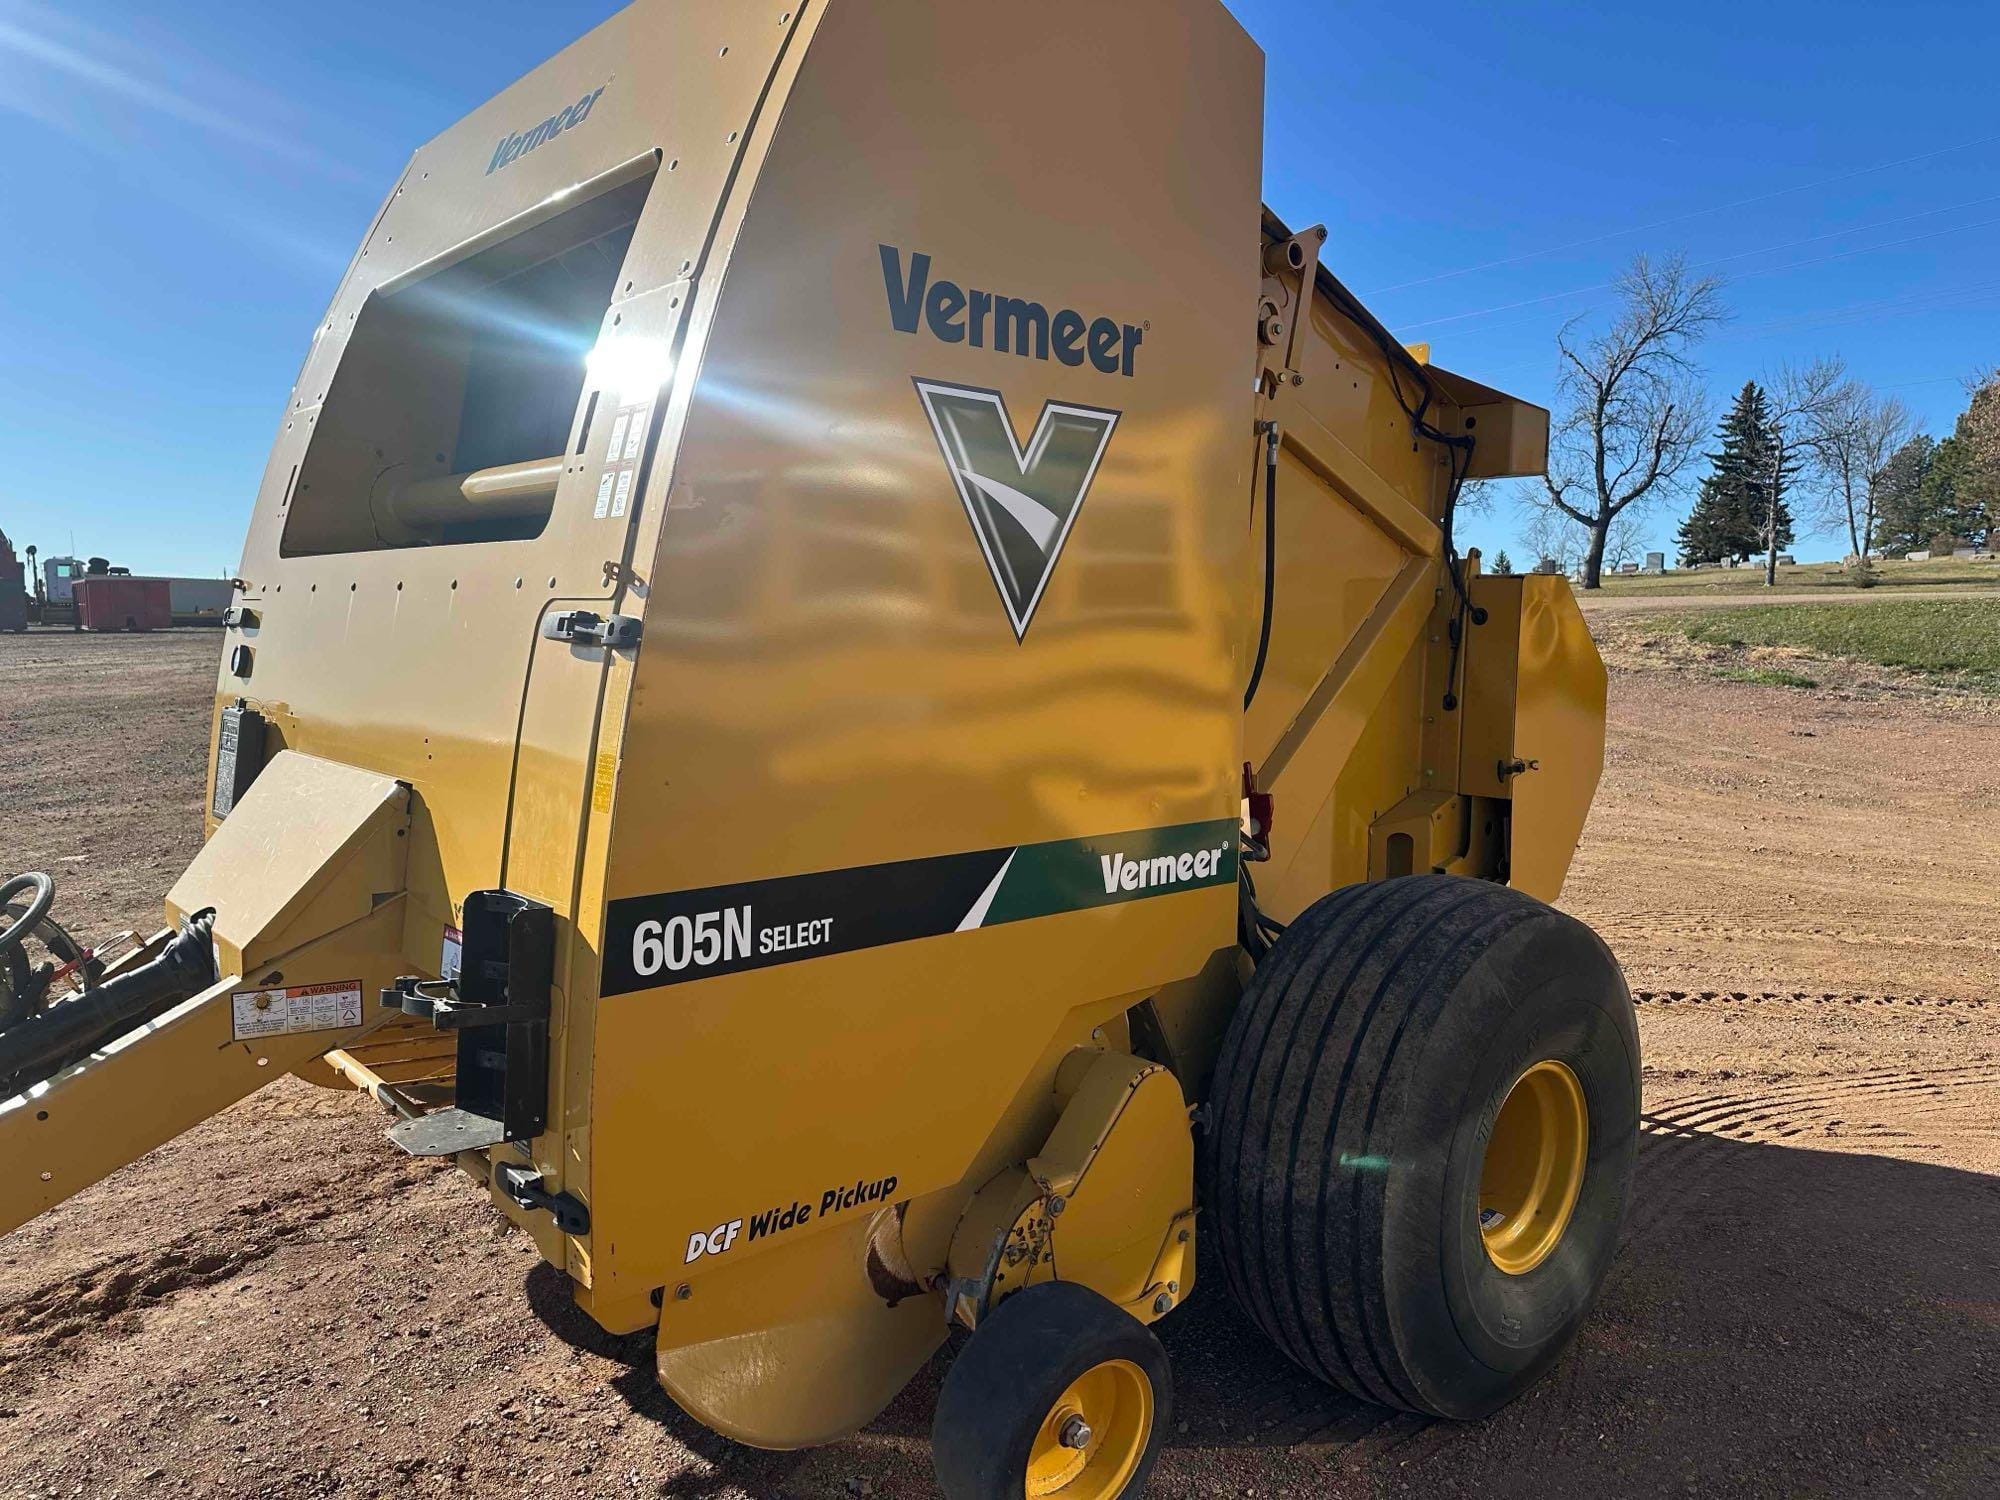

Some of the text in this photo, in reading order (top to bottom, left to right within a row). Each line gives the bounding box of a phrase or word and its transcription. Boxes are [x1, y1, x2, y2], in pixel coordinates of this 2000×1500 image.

[485, 84, 606, 176] Vermeer
[879, 244, 1142, 377] Vermeer
[1101, 849, 1221, 893] Vermeer
[633, 905, 833, 976] 605N SELECT
[310, 983, 356, 994] WARNING
[684, 1175, 898, 1264] DCF Wide Pickup
